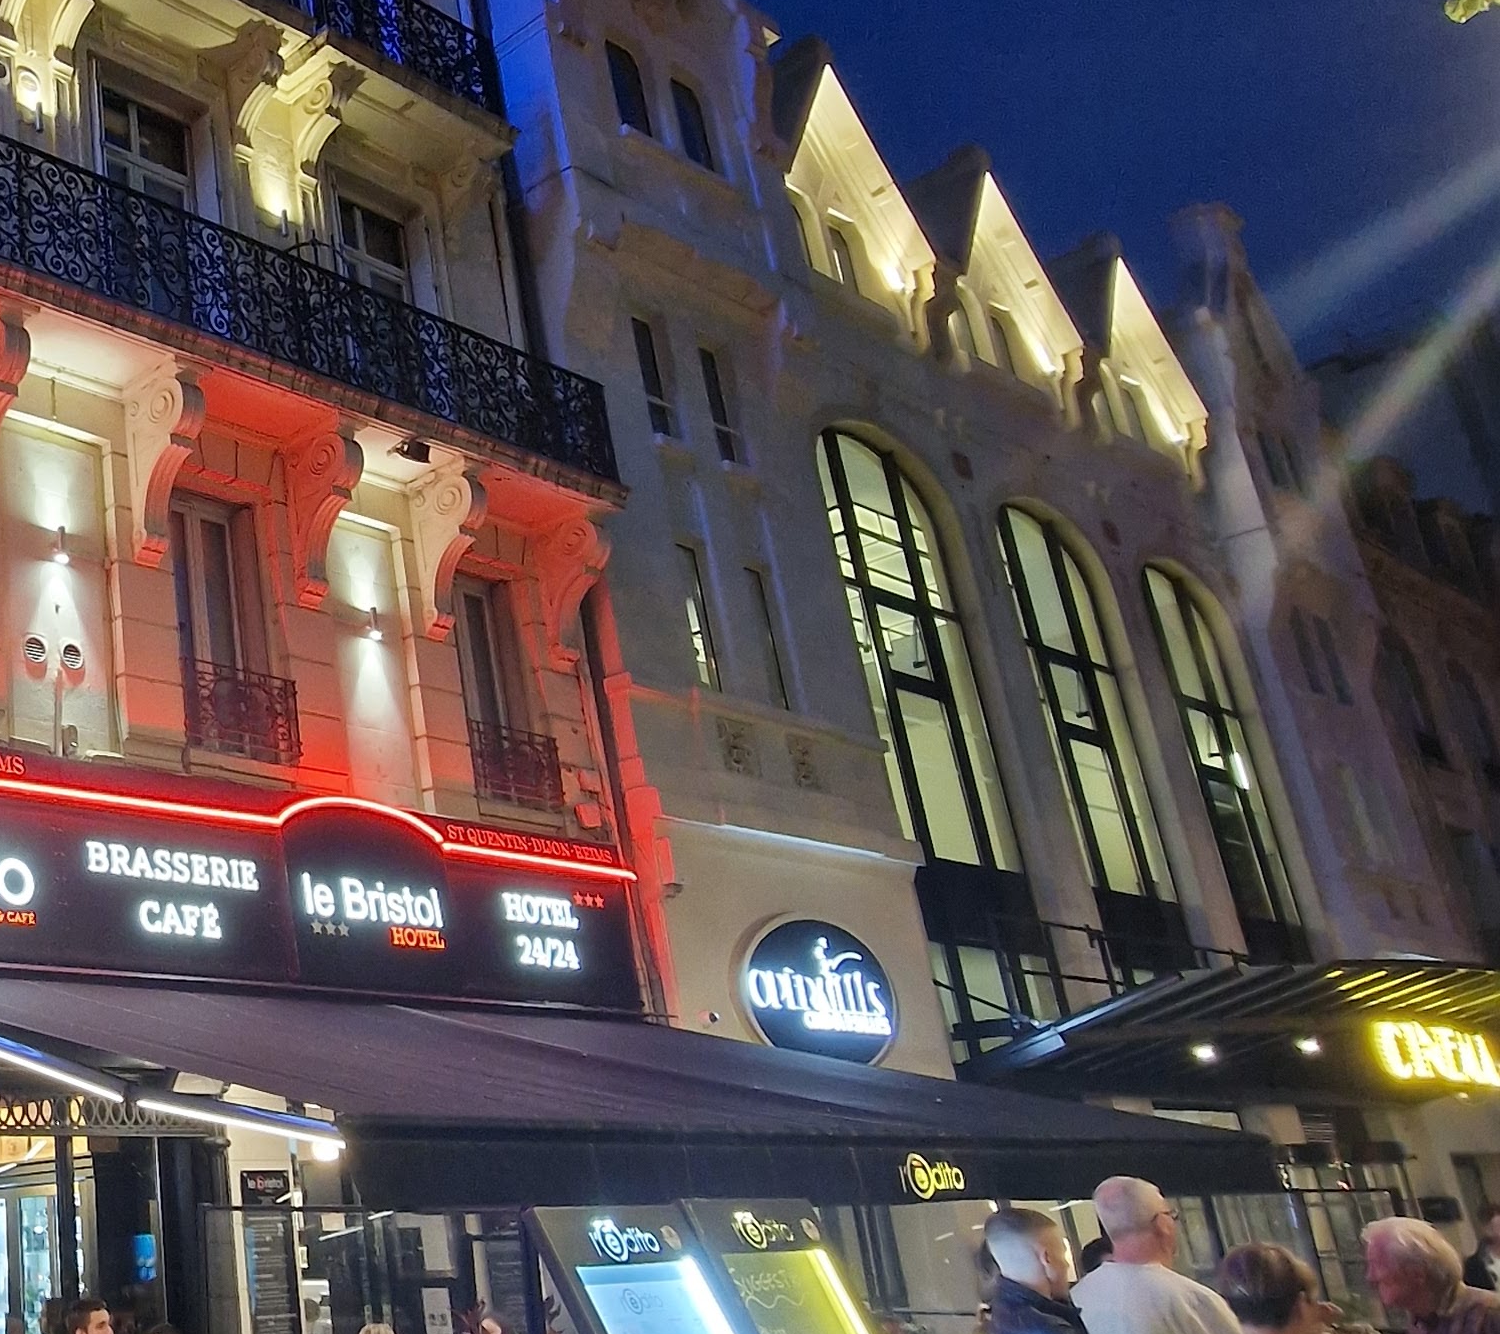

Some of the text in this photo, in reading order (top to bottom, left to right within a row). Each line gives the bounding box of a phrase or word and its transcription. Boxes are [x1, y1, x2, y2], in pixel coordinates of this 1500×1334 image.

[447, 824, 465, 841] ST
[86, 840, 260, 891] BRASSERIE
[302, 871, 444, 928] le Bristol
[501, 892, 580, 929] HOTEL
[7, 911, 36, 925] CAFÉ
[139, 900, 223, 939] CAFÉ
[391, 926, 445, 949] HOTEL
[516, 934, 581, 970] 24/24
